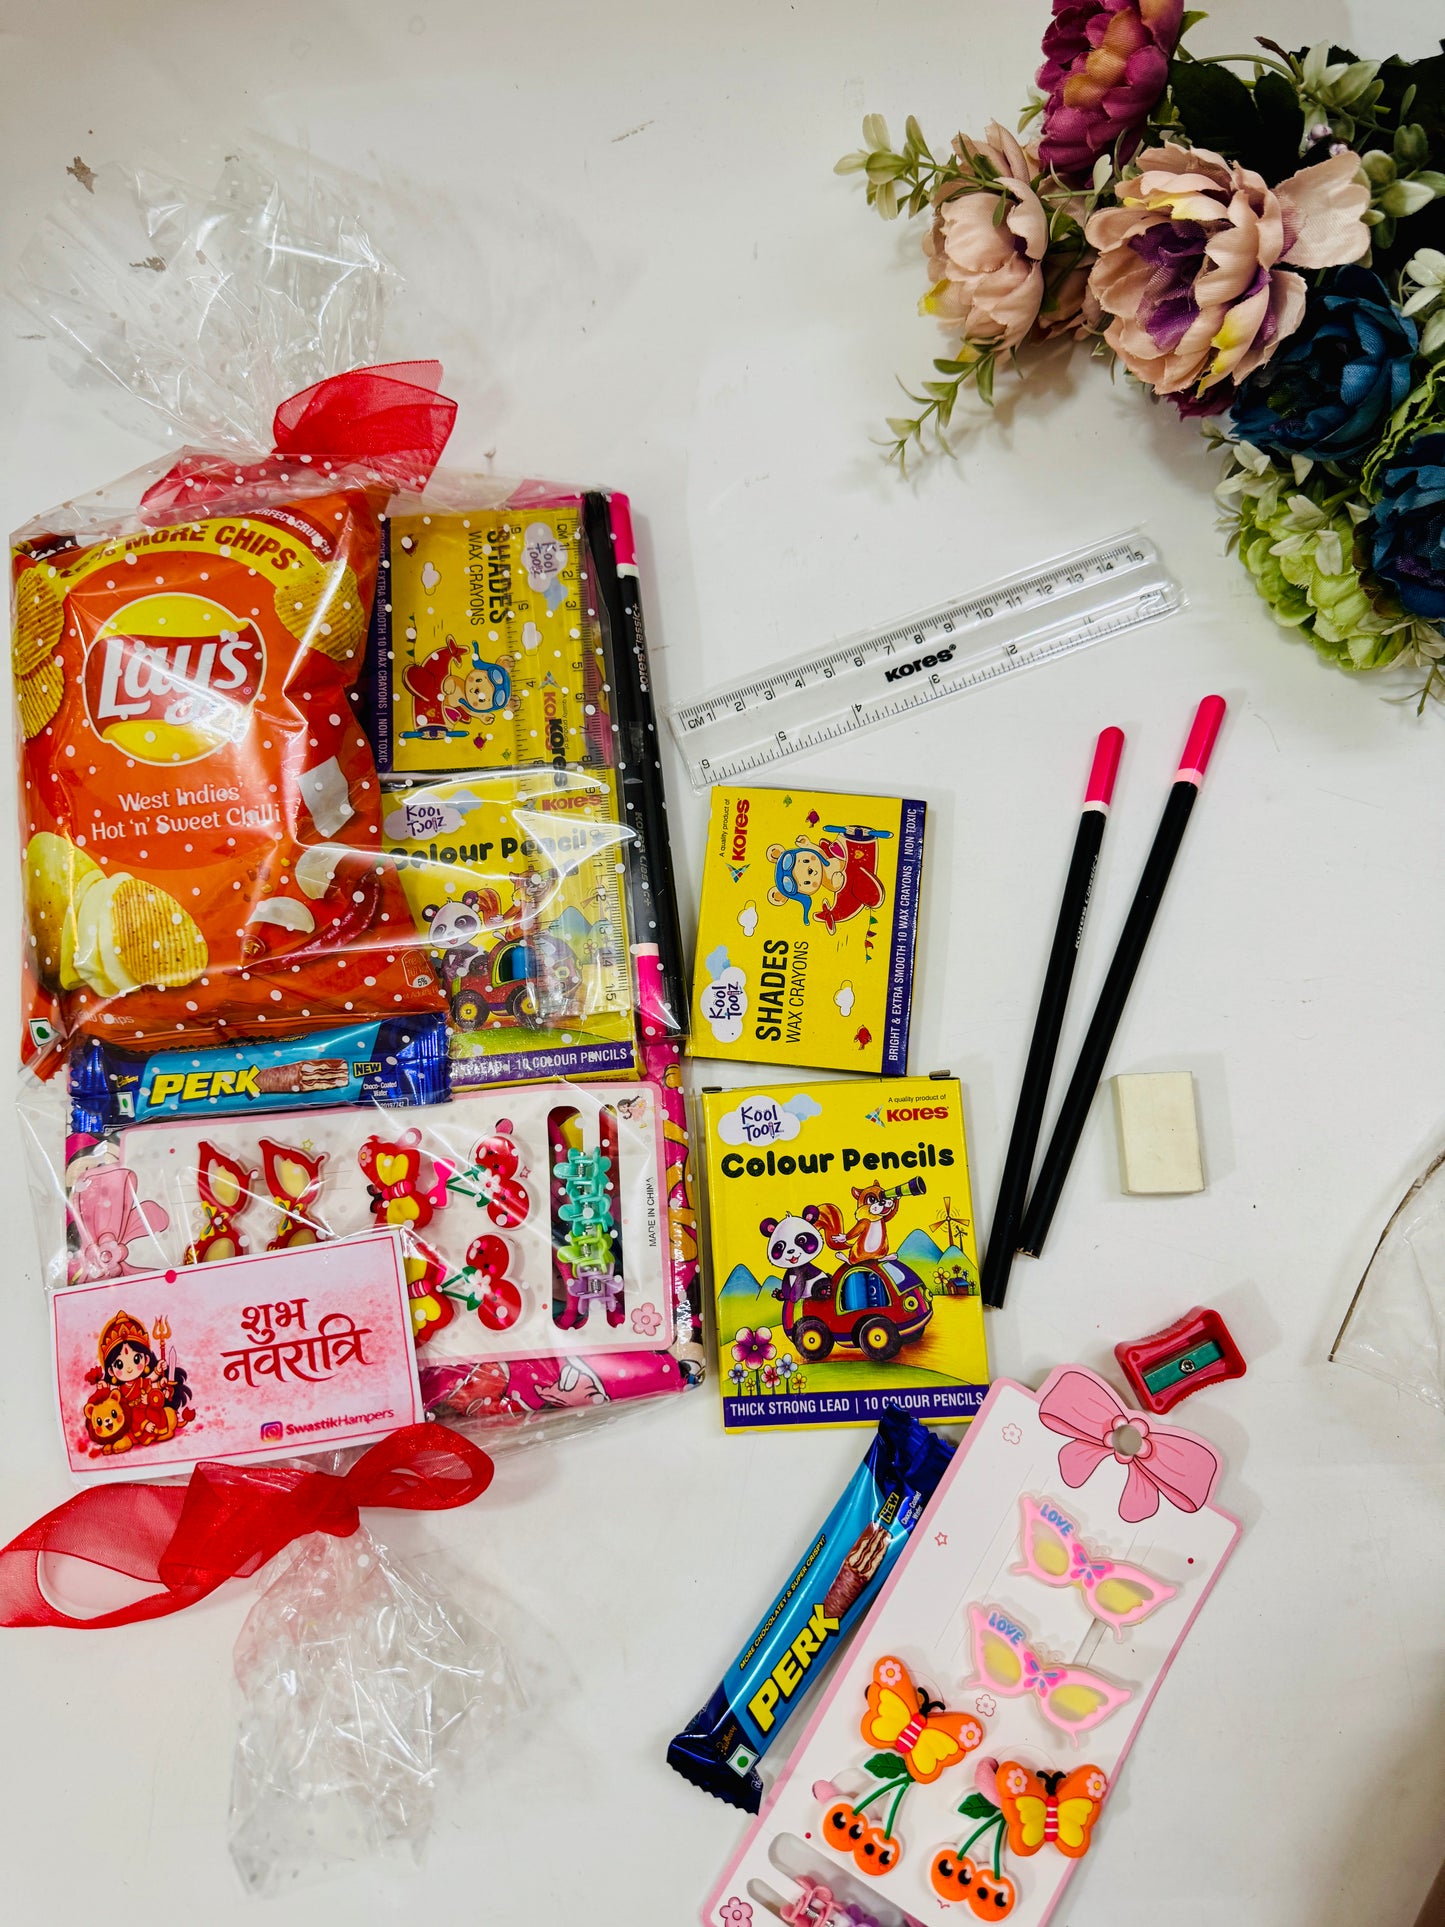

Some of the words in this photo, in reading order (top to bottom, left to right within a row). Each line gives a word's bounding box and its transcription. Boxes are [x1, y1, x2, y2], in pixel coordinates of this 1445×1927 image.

[125, 523, 207, 551] MORE
[294, 519, 333, 556] CRUCH
[468, 530, 483, 561] WAX
[487, 529, 512, 625] SHADES
[468, 564, 485, 626] CRAYONS
[377, 598, 388, 634] SMOOTH
[378, 648, 388, 668] WAX
[687, 717, 706, 729] CM
[734, 701, 744, 712] 2
[764, 690, 774, 701] 3
[794, 679, 803, 688] 4
[823, 668, 833, 679] 5
[854, 656, 863, 668] 6
[883, 645, 892, 656] 7
[913, 633, 924, 645] 8
[943, 621, 953, 633] 9
[975, 607, 994, 620] 10
[97, 630, 253, 725] Lay's
[377, 670, 388, 709] CRAYONS
[378, 718, 388, 737] NON
[378, 738, 388, 763] TOXIC
[118, 790, 170, 813] West
[91, 822, 127, 841] Hot
[156, 812, 220, 835] Sweet
[226, 803, 281, 828] Chilli
[905, 808, 917, 834] TOXIC
[389, 842, 494, 871] Colour
[904, 834, 915, 856] NON
[900, 865, 913, 908] CRAYONS
[898, 907, 910, 930] WAX
[897, 931, 907, 943] 10
[788, 940, 809, 1007] CRAYONS
[893, 943, 906, 984] SMOOTH
[709, 985, 727, 1019] Kool
[755, 939, 790, 1042] SHADES
[891, 985, 903, 1016] EXTRA
[786, 1010, 803, 1044] WAX
[891, 1016, 901, 1025] &
[888, 1027, 900, 1062] BRIGHT
[354, 1063, 381, 1076] NEW
[533, 1053, 578, 1069] COLOUR
[150, 1064, 262, 1105] PERK
[893, 1096, 914, 1104] quality
[915, 1093, 939, 1103] product
[740, 1104, 778, 1125] Kool
[720, 1150, 835, 1179] Colour
[842, 1141, 955, 1172] Pencils
[645, 1176, 655, 1206] CHINA
[647, 1208, 656, 1219] IN
[647, 1220, 657, 1247] MADE
[240, 1297, 311, 1345] शुभ
[219, 1312, 376, 1388] नवरात्रि
[730, 1401, 766, 1417] THICK
[768, 1398, 816, 1415] STRONG
[819, 1398, 850, 1413] LEAD
[864, 1396, 879, 1410] 10
[881, 1393, 930, 1410] COLOUR
[933, 1391, 984, 1407] PENCILS
[286, 1408, 395, 1436] SwastikHampers
[880, 1492, 899, 1523] NEW
[1040, 1503, 1074, 1537] LOVE
[740, 1646, 756, 1669] MORE
[754, 1596, 788, 1648] CHOCOLATEY
[790, 1566, 808, 1591] SUPER
[988, 1612, 1026, 1646] LOVE
[748, 1603, 841, 1732] PERK
